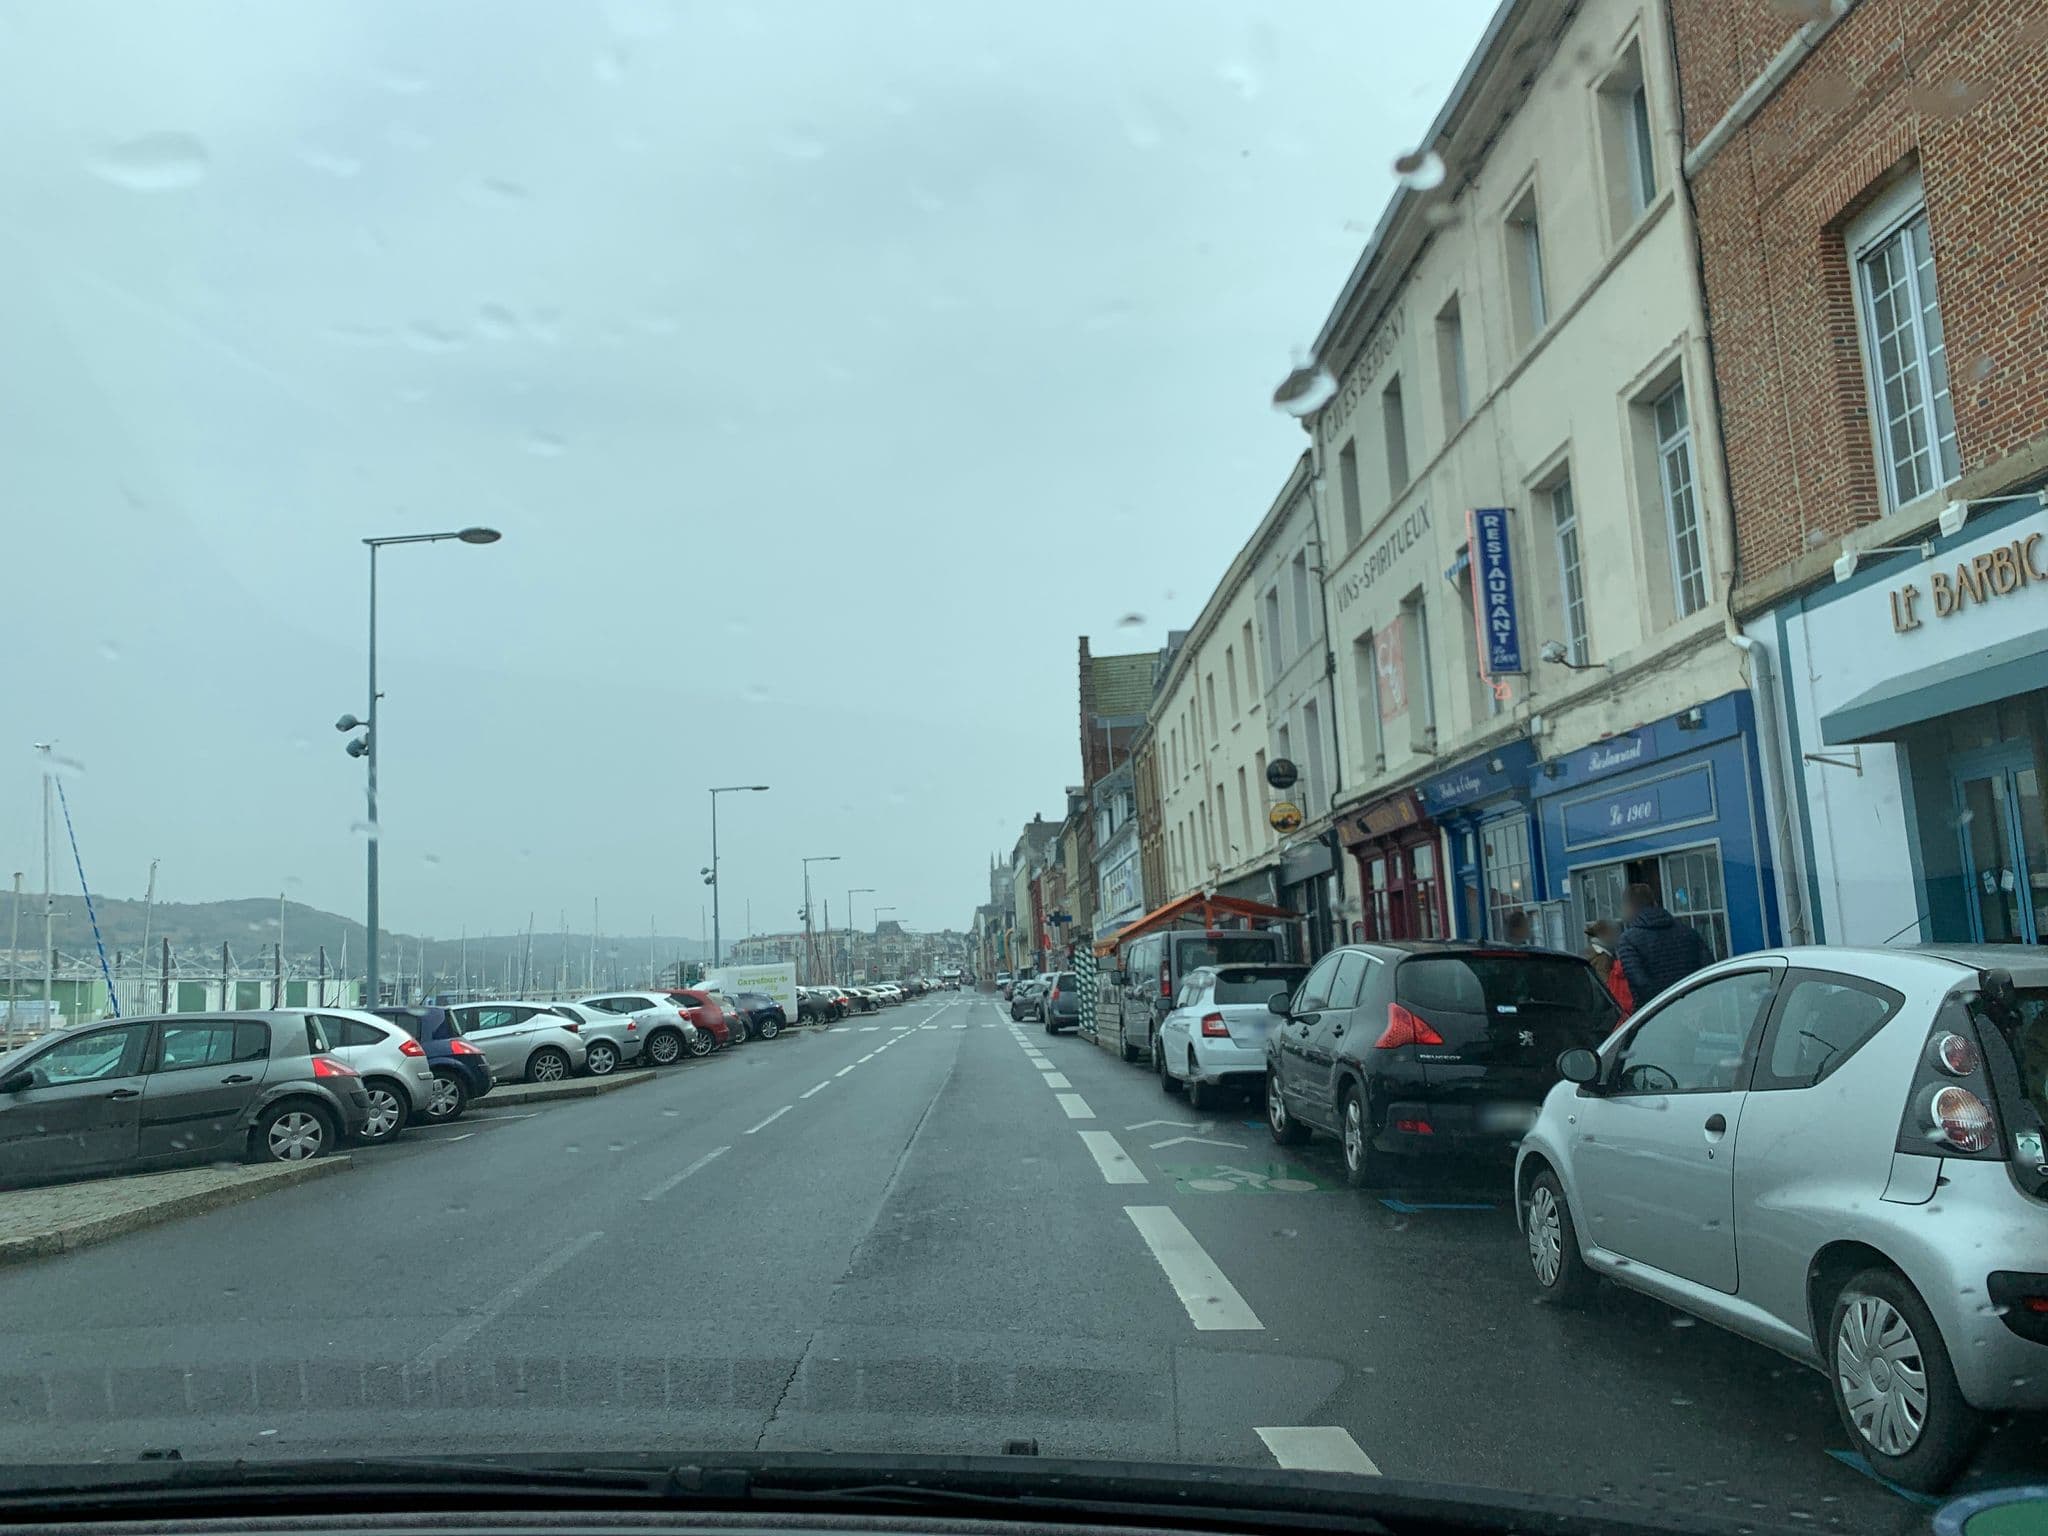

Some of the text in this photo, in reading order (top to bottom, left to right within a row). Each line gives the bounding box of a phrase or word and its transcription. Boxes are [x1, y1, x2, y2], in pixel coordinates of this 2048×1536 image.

[1483, 515, 1512, 645] RESTAURANT
[1889, 532, 2048, 634] LE BARBIC
[1626, 800, 1653, 823] 1900
